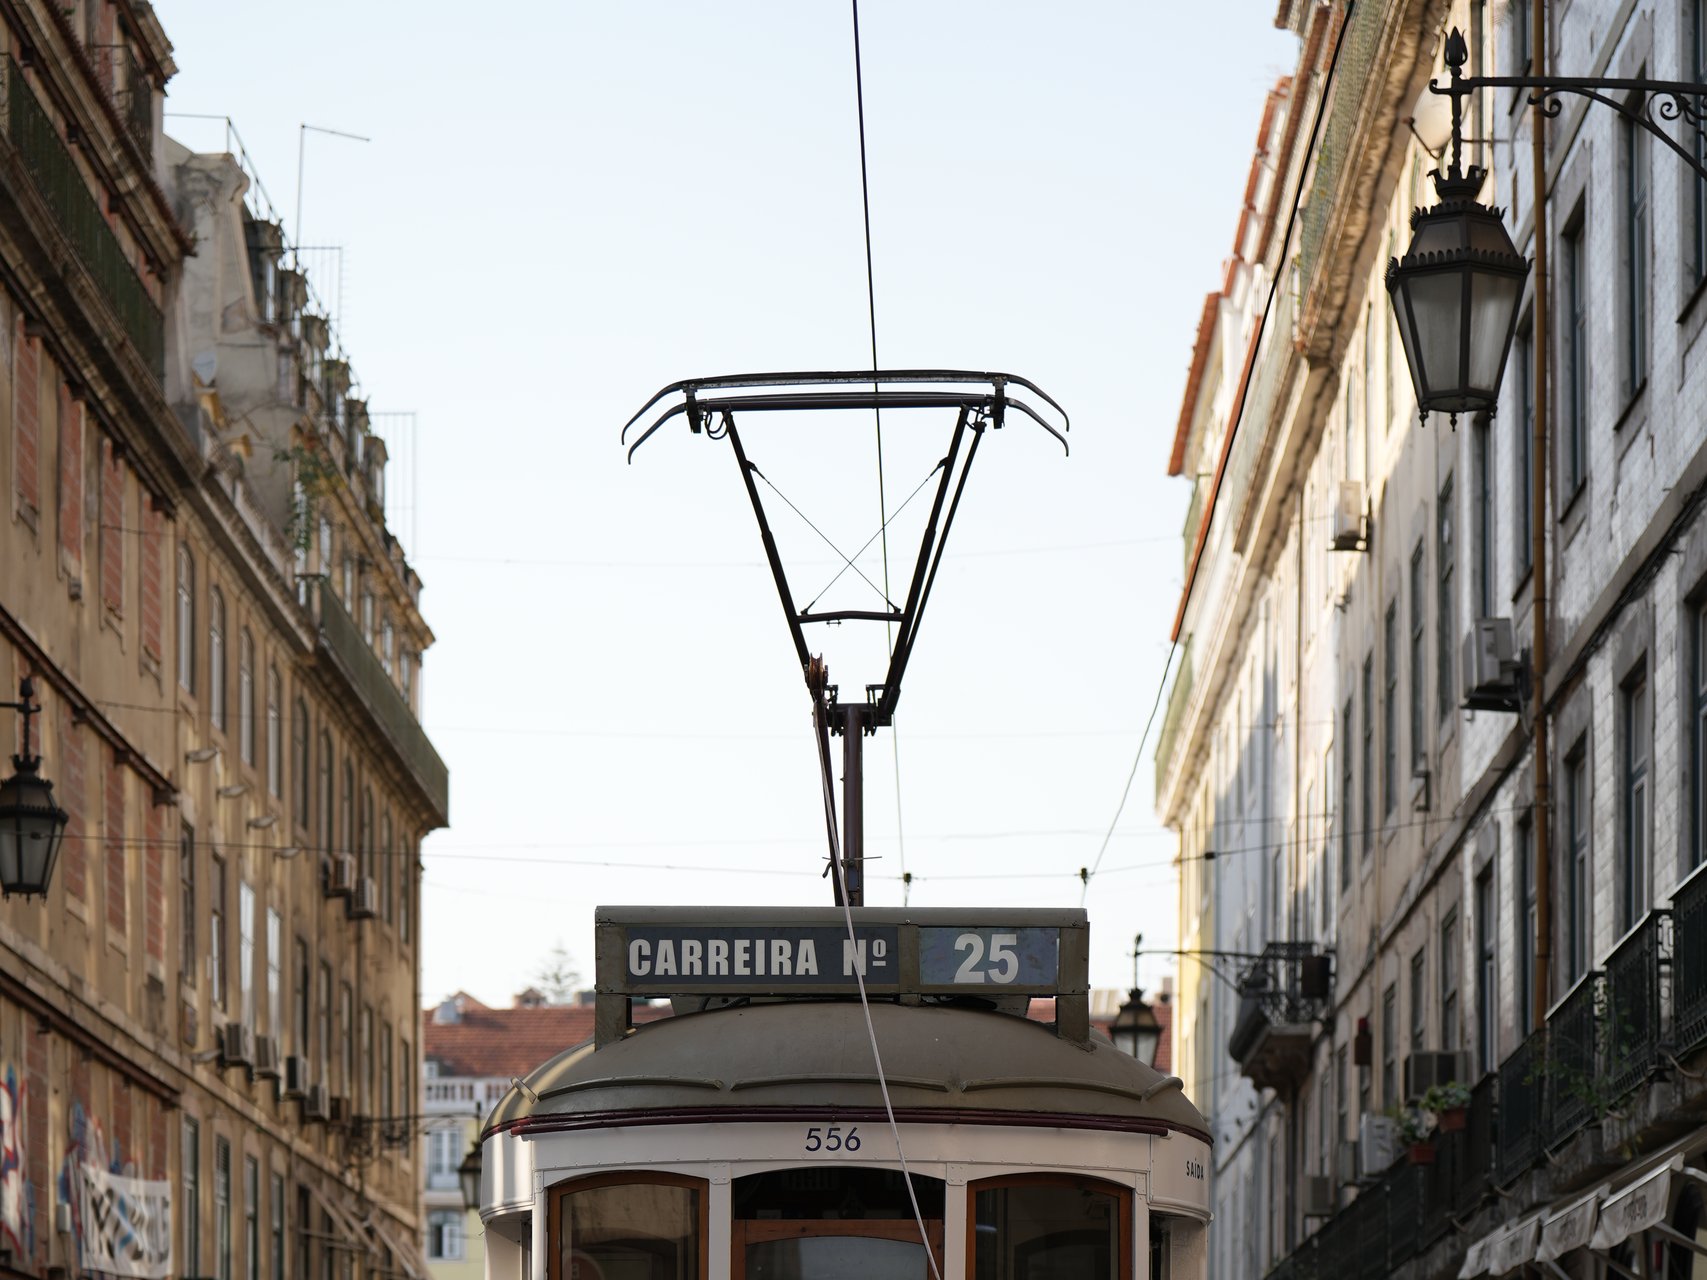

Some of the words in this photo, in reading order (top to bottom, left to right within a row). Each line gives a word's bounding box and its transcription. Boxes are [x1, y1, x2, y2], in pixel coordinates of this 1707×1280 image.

[629, 938, 818, 976] CARREIRA
[953, 933, 1019, 984] 25
[805, 1126, 861, 1152] 556
